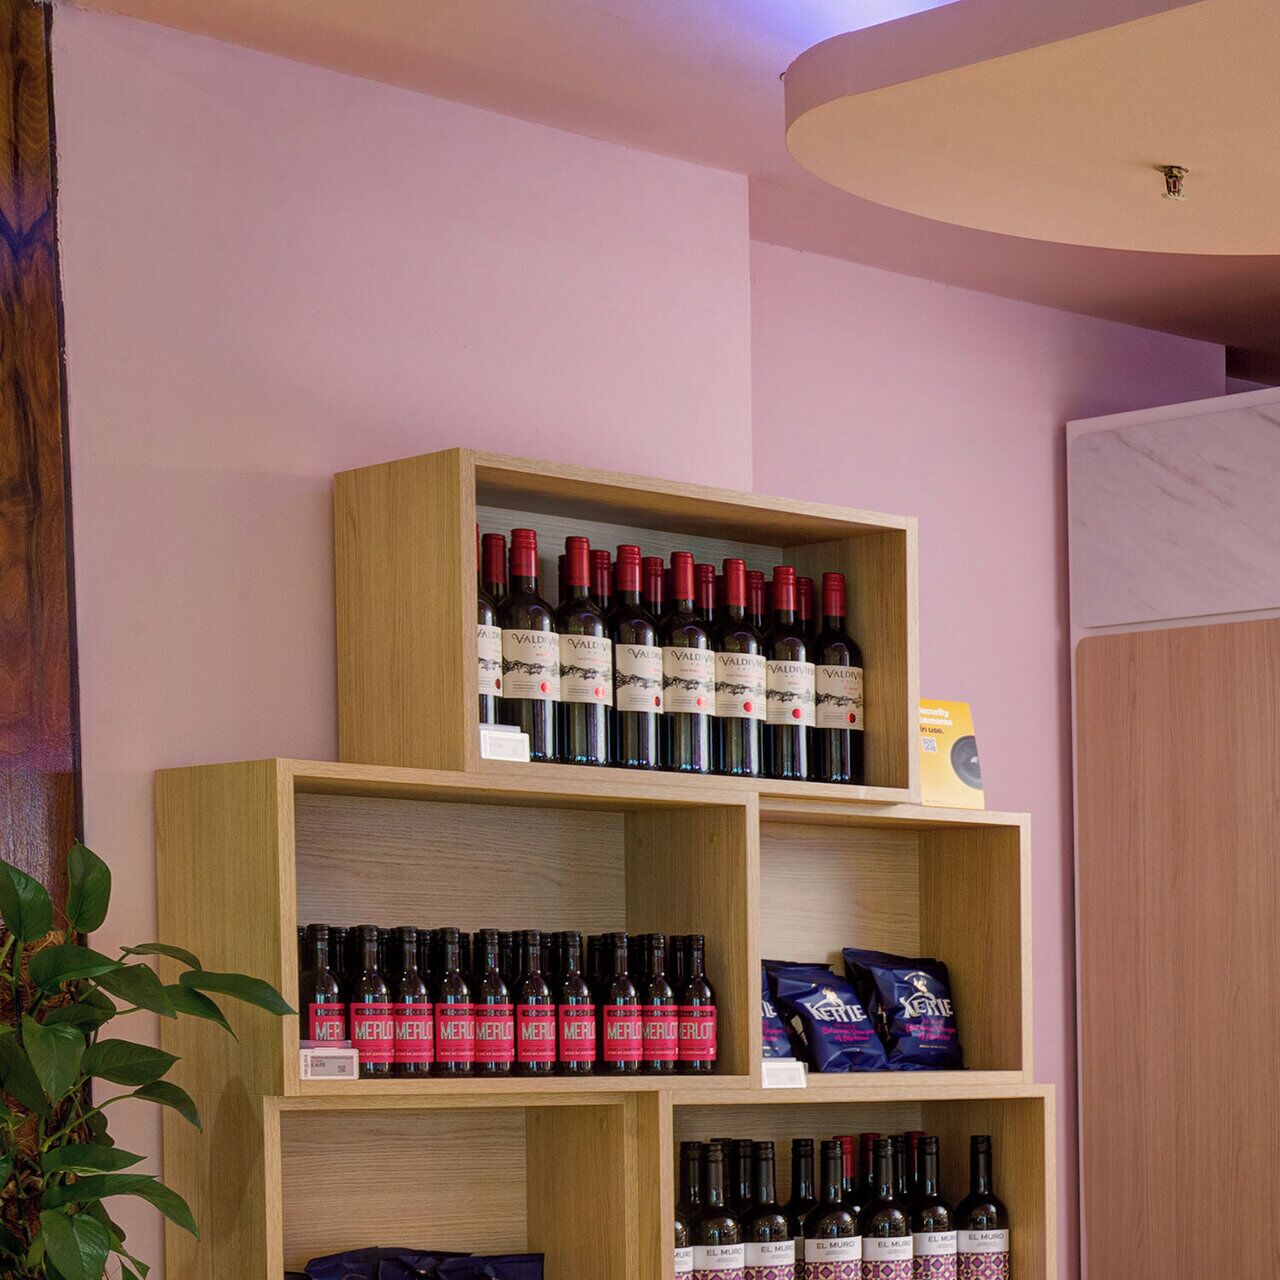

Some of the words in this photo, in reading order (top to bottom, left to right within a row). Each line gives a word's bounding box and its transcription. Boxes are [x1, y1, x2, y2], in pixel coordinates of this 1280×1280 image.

[919, 707, 949, 718] ecurity
[804, 1000, 867, 1022] KETTLE
[900, 993, 953, 1018] KETTLE
[355, 1021, 394, 1039] MERLO
[395, 1021, 433, 1039] MERLO
[476, 1021, 514, 1039] MERLO
[522, 1021, 556, 1039] MERLO
[608, 1022, 642, 1039] MERLO
[643, 1022, 678, 1039] MERLO
[680, 1022, 713, 1039] ERLOT
[707, 1249, 719, 1257] EL
[878, 1241, 889, 1249] EL
